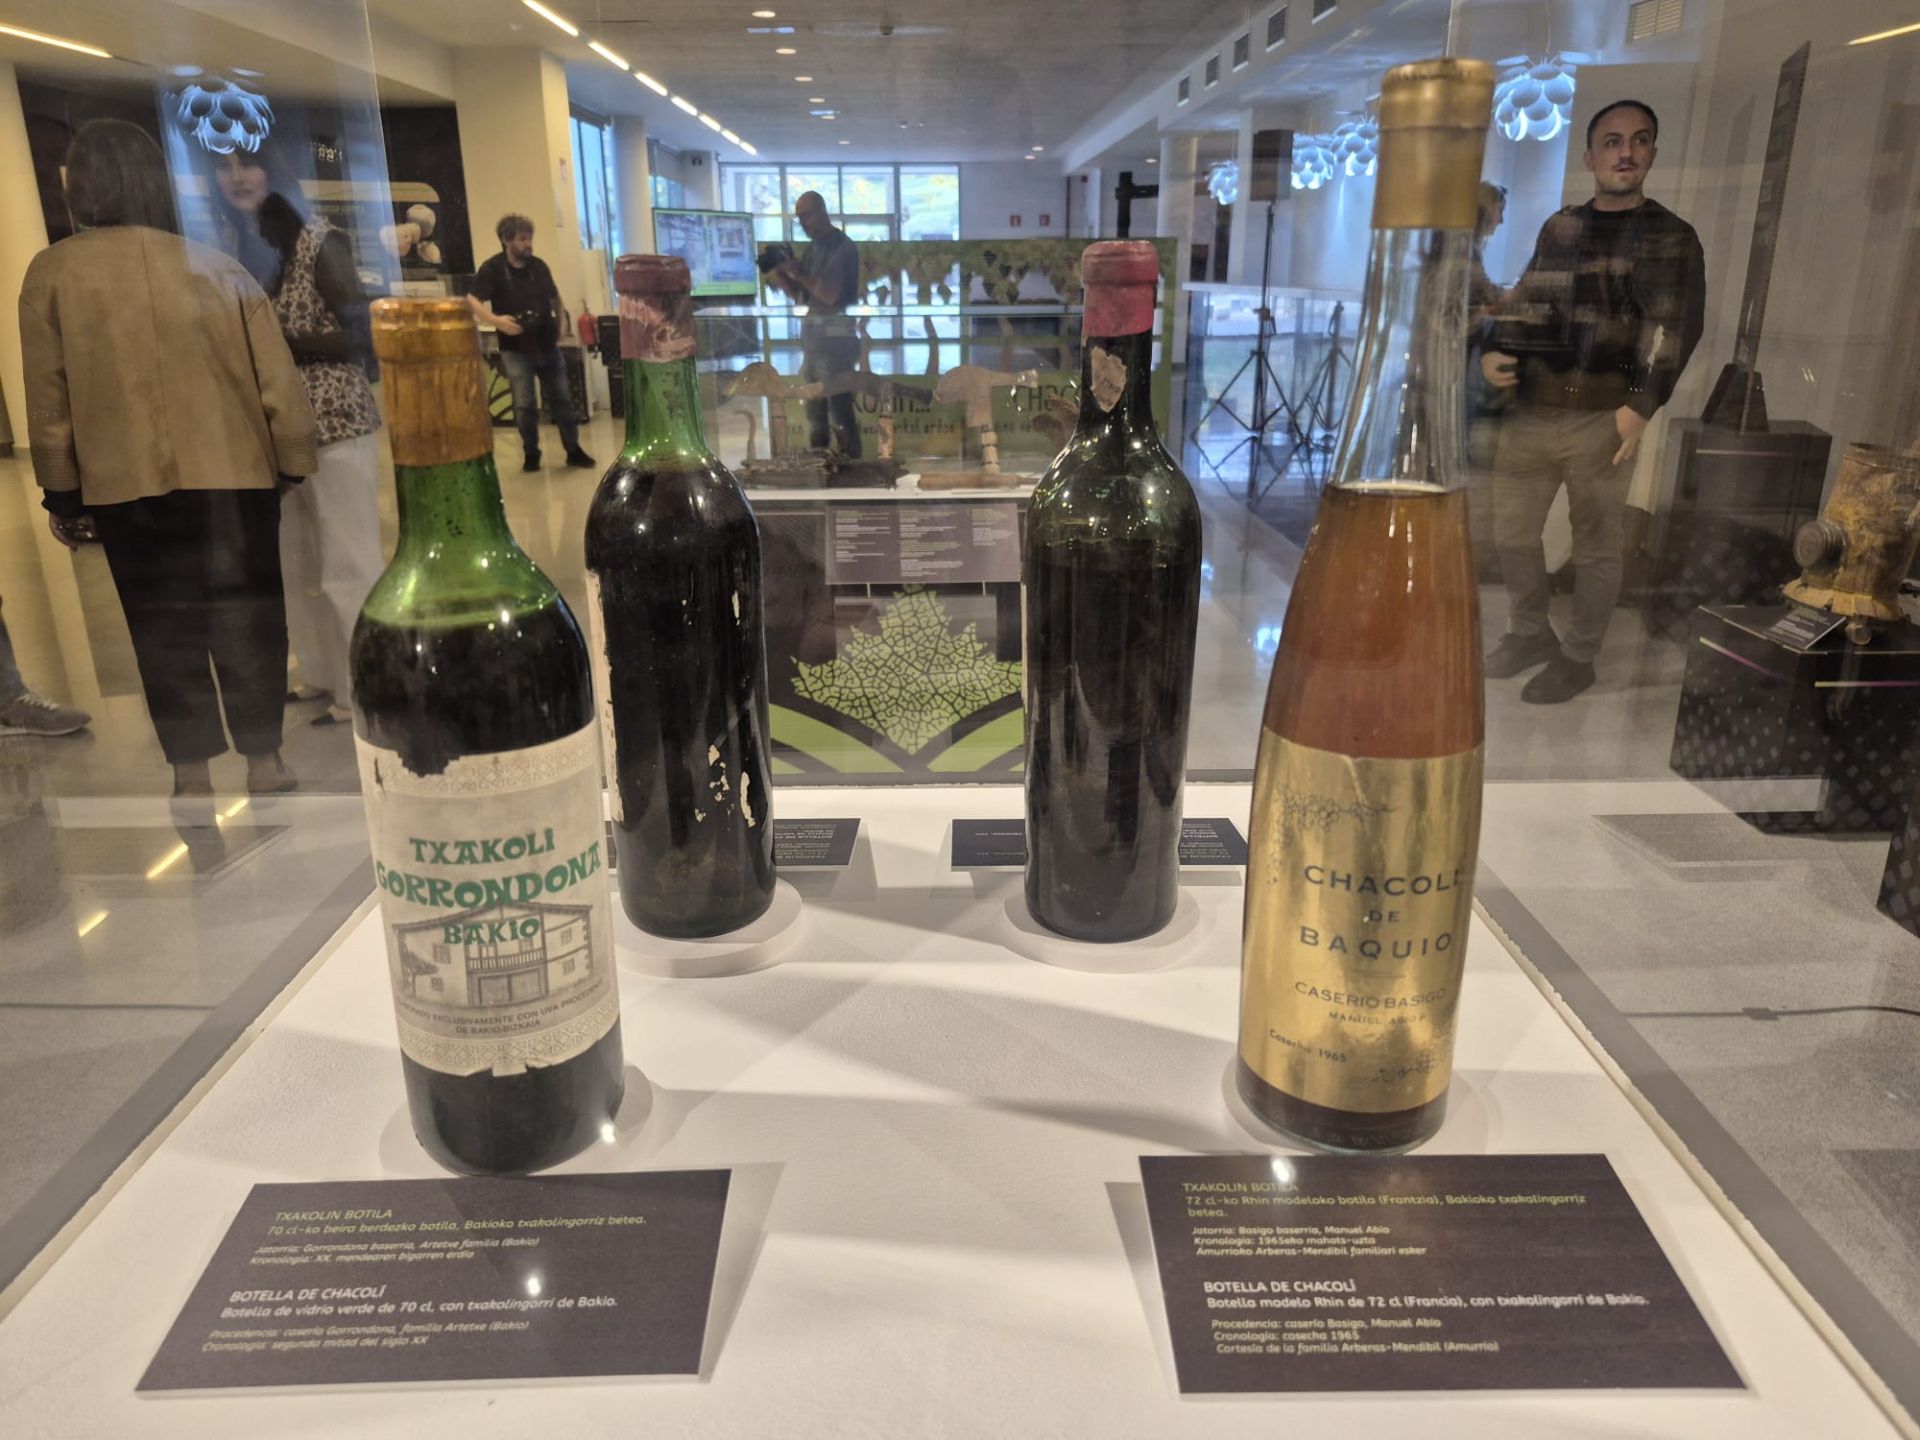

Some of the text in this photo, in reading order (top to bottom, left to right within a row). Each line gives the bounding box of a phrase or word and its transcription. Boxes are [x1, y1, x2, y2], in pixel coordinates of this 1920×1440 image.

[409, 828, 555, 865] TXAKOLI
[376, 841, 602, 909] GORRONDONA
[1369, 911, 1400, 923] DE
[443, 918, 541, 945] BAKIO
[1300, 927, 1452, 959] BAQUIO
[1295, 982, 1447, 1009] CASERIO BASIGO
[433, 1014, 514, 1026] EXCLUSIVAMENTE
[517, 1010, 539, 1021] CON
[541, 1004, 559, 1016] UVA
[456, 1020, 541, 1035] DE BAKIO-BIZKAIA
[1318, 1048, 1348, 1063] 1965
[1182, 1181, 1299, 1192] TXAKOLIN BOTILA
[1185, 1196, 1202, 1206] 72
[1241, 1195, 1270, 1205] Rhin
[1445, 1194, 1497, 1205] Bakioko
[275, 1209, 393, 1221] TXAKOLIN BOTILA
[1188, 1207, 1230, 1217] betea.
[267, 1226, 284, 1236] 70
[358, 1222, 416, 1233] berdezko
[464, 1219, 514, 1230] Bakioko
[517, 1215, 604, 1229] txakolingorriz
[607, 1215, 647, 1225] betea.
[1238, 1226, 1274, 1236] Basigo
[1324, 1225, 1364, 1235] Manuel
[1365, 1225, 1391, 1234] Abio
[303, 1242, 368, 1253] Gorrondona
[229, 1283, 388, 1302] BOTELLA DE CHACOLÍ
[1204, 1278, 1357, 1293] BOTELLA DE CHACOLÍ
[220, 1306, 271, 1318] Botella
[273, 1305, 291, 1316] de
[295, 1303, 335, 1315] vidrio
[337, 1303, 375, 1314] verde
[377, 1301, 396, 1313] de
[398, 1301, 417, 1312] 70
[439, 1301, 464, 1312] con
[467, 1296, 555, 1311] txakolingorri
[557, 1296, 575, 1308] de
[577, 1295, 618, 1307] Bakio.
[1207, 1298, 1257, 1309] Botella
[1259, 1297, 1311, 1308] modelo
[1313, 1296, 1345, 1307] Rhin
[1347, 1296, 1366, 1307] de
[1368, 1296, 1387, 1307] 72
[1388, 1296, 1402, 1307] cl
[1403, 1295, 1468, 1309] (Francia),
[1470, 1296, 1495, 1307] con
[1497, 1294, 1583, 1309] txakolingorri
[1585, 1294, 1604, 1306] de
[1212, 1319, 1282, 1329] Procedencia:
[1371, 1317, 1414, 1328] Manuel
[1415, 1317, 1442, 1327] Abio
[410, 1335, 430, 1345] XX
[1282, 1330, 1328, 1341] cosecha
[1330, 1330, 1361, 1341] 1965
[1266, 1343, 1281, 1353] de
[1282, 1343, 1294, 1353] la
